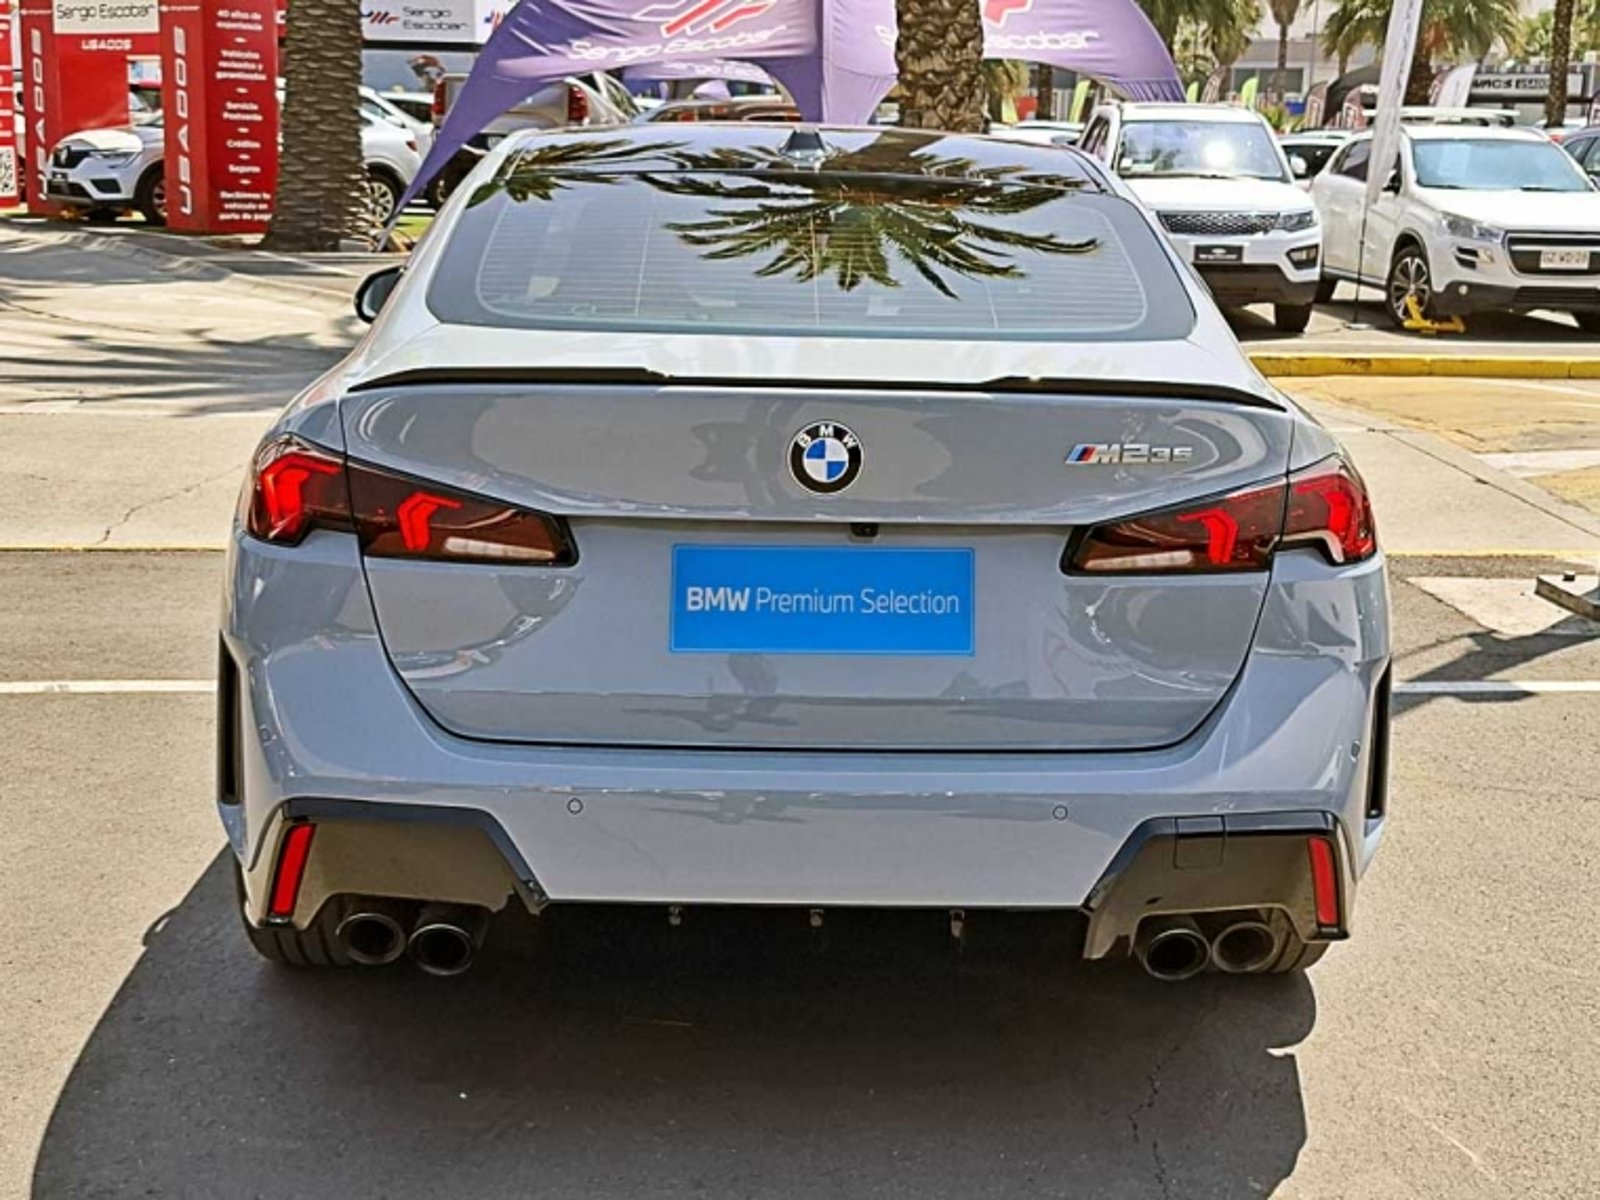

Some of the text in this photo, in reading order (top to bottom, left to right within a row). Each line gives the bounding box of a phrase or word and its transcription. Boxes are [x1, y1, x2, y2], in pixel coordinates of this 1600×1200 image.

[100, 3, 155, 18] Escobar
[403, 19, 468, 31] Escobar
[81, 39, 132, 50] USADOS
[663, 25, 788, 54] Escobar
[984, 30, 1099, 48] scobar
[173, 25, 192, 215] USADOS
[796, 424, 859, 449] BMW
[1092, 443, 1193, 465] M235
[686, 587, 960, 615] BMW Premium Selection
